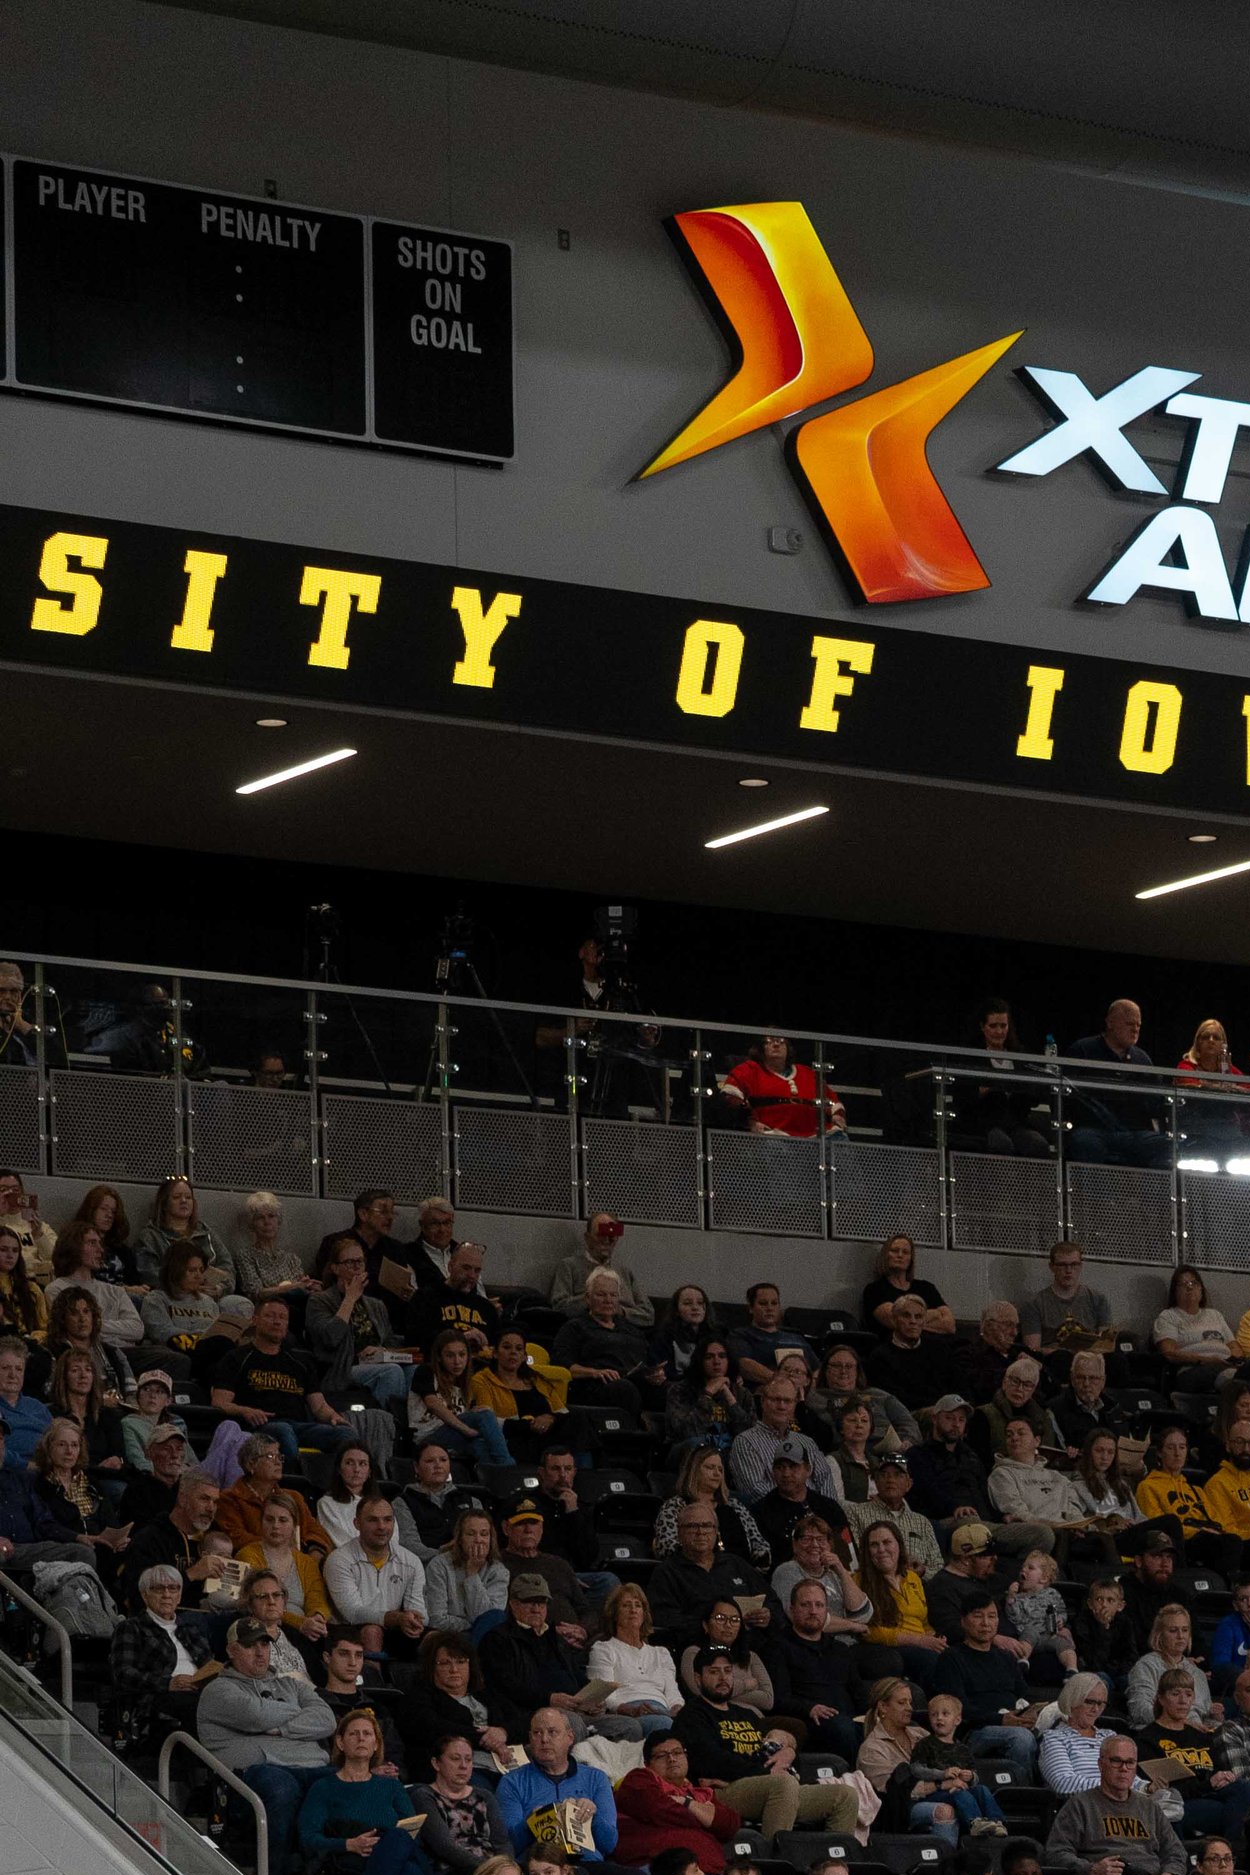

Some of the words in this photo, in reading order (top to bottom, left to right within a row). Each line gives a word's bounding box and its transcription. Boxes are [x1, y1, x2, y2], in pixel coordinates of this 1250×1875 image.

[37, 175, 148, 224] PLAYER
[201, 202, 323, 252] PENALTY
[397, 236, 488, 282] SHOTS
[424, 278, 463, 315] ON
[410, 315, 483, 355] GOAL
[31, 531, 523, 689] SITY
[676, 619, 876, 733] OF
[441, 1303, 488, 1326] IOWA
[1166, 1747, 1214, 1768] OWA
[1102, 1816, 1151, 1839] IOWA
